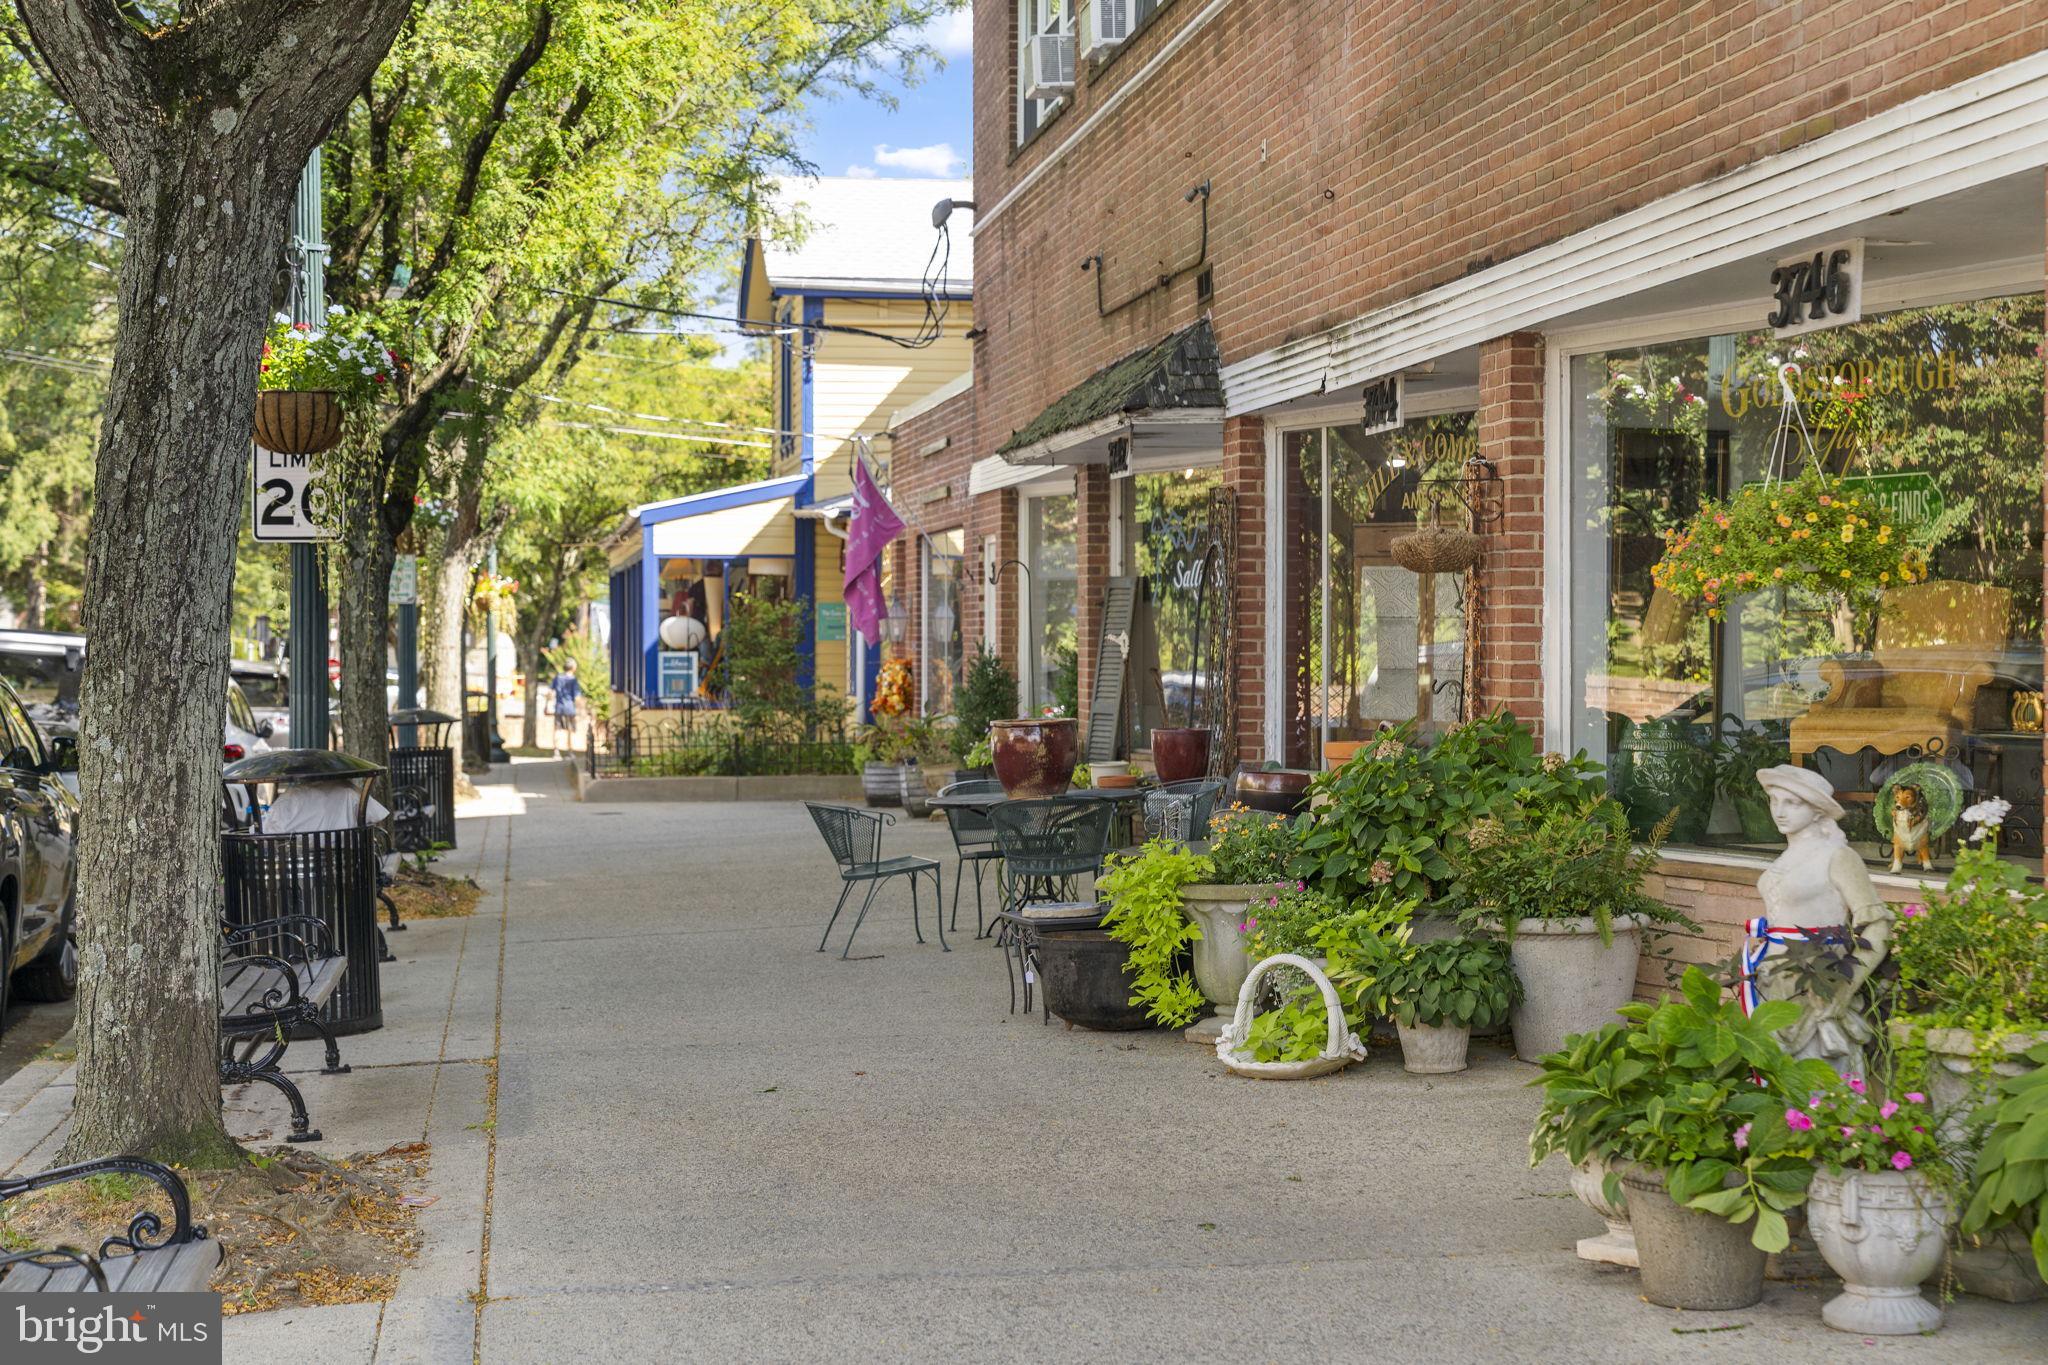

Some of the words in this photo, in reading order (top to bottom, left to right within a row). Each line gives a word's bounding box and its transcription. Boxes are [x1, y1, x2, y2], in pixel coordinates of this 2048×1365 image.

[1768, 249, 1850, 328] 3746
[261, 478, 334, 526] 20
[1366, 447, 1400, 510] JILL
[1405, 441, 1416, 470] &
[1892, 489, 1931, 525] FINDS
